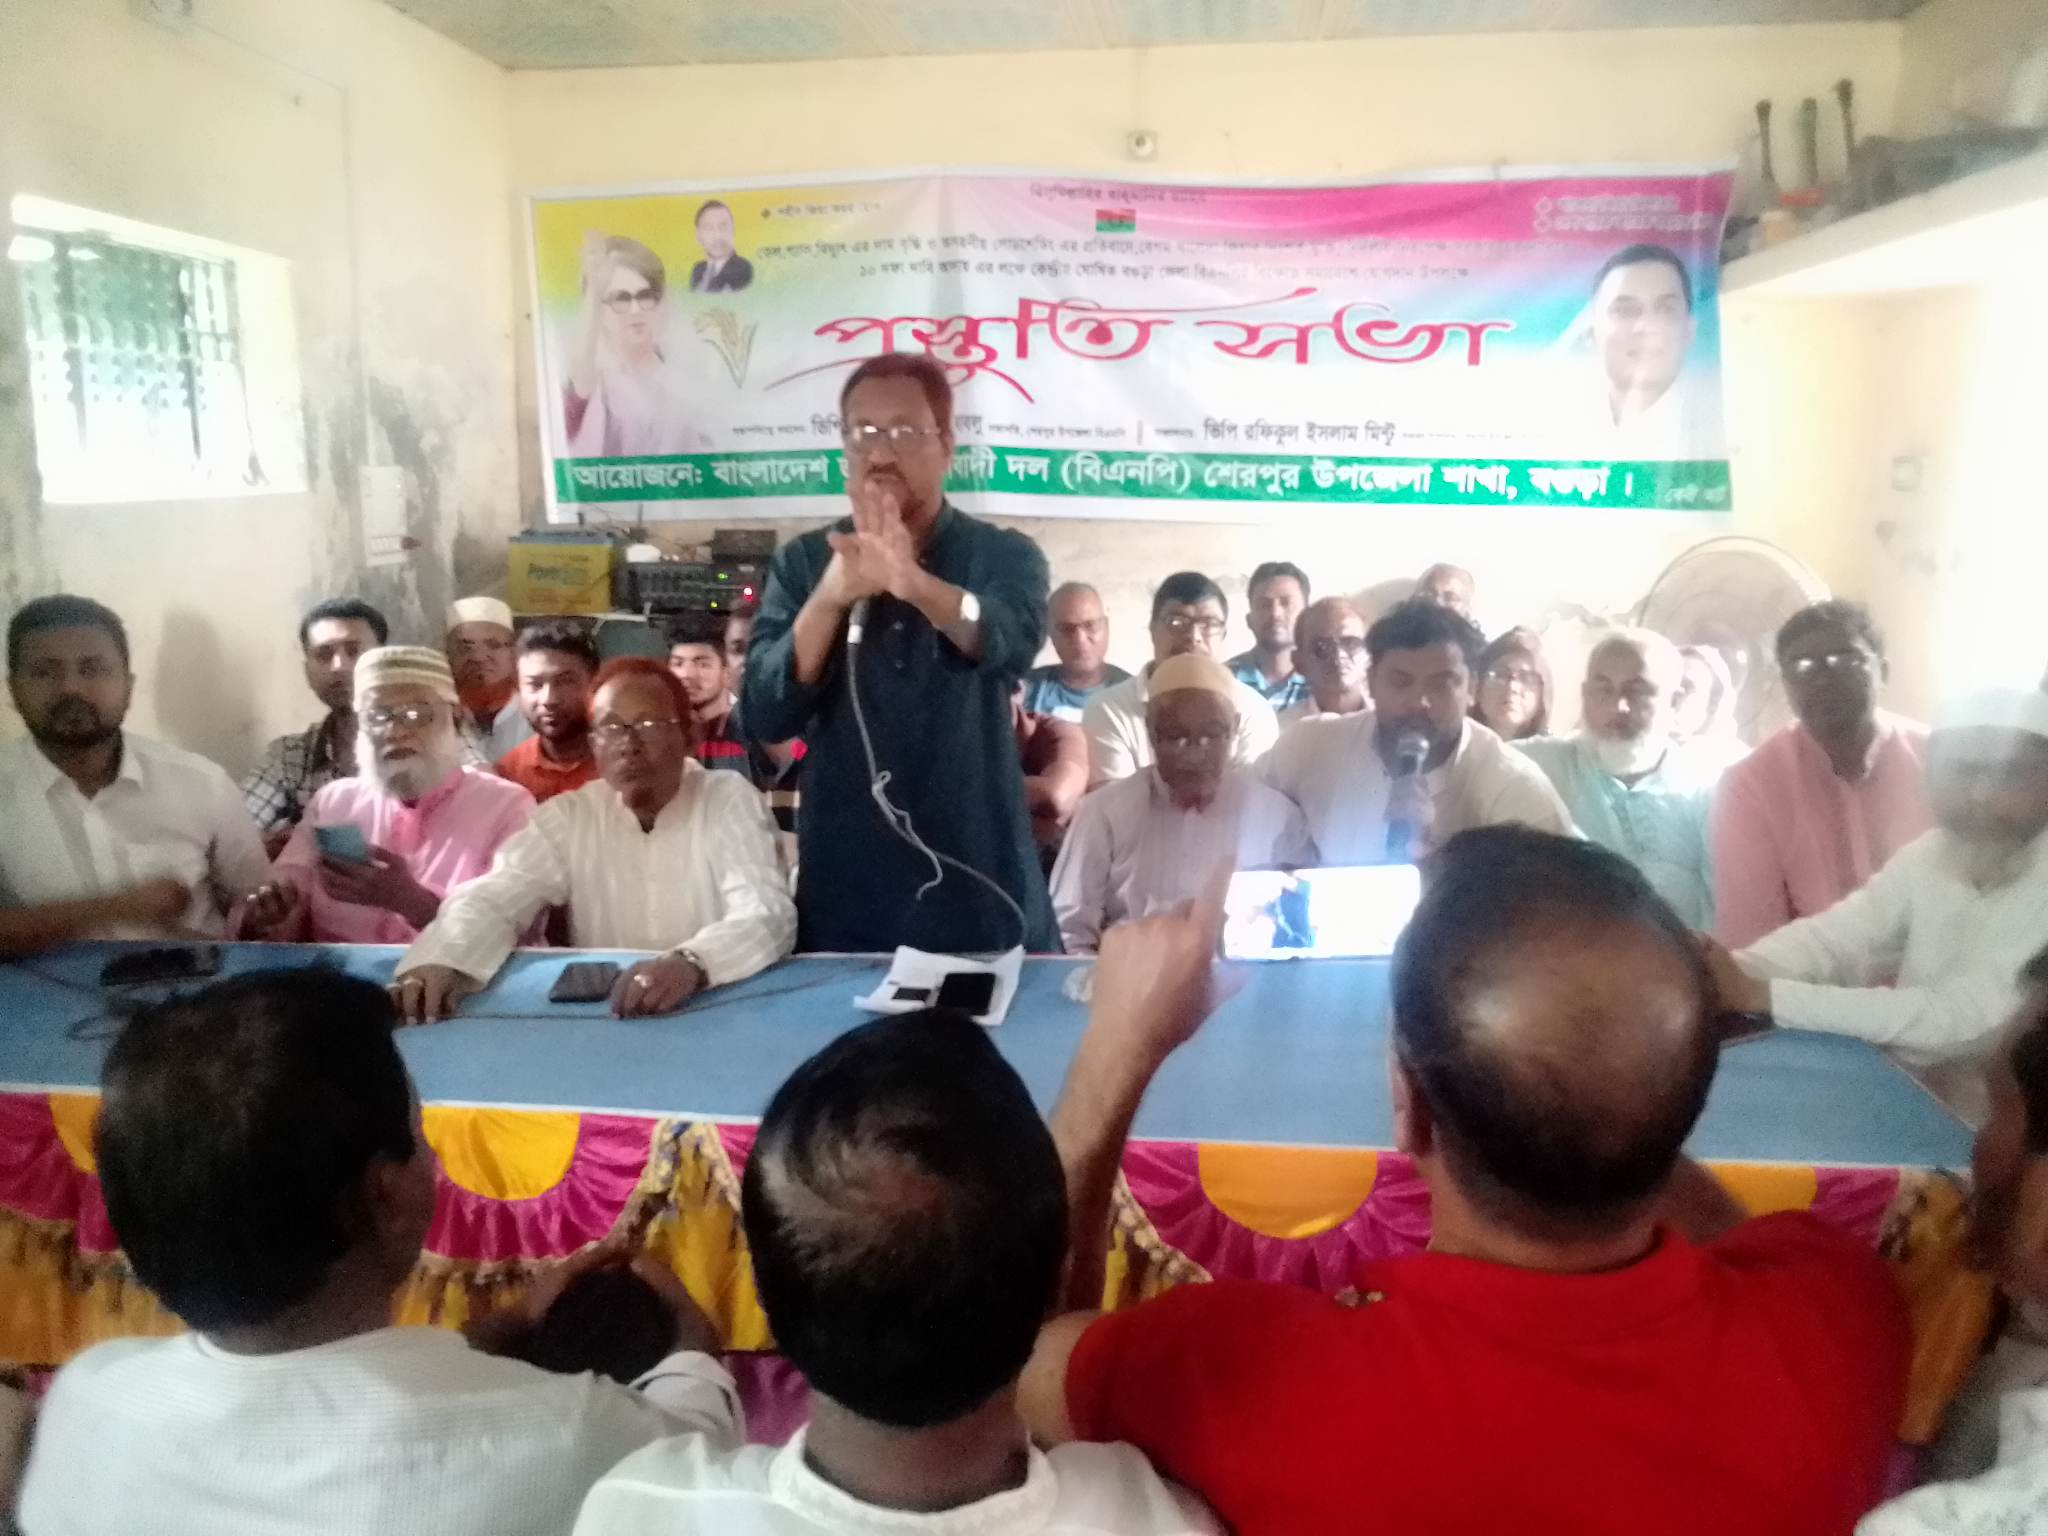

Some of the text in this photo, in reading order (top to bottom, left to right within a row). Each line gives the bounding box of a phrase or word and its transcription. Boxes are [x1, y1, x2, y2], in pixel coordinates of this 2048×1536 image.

[1194, 303, 1514, 365] সভা
[1306, 420, 1358, 441] ইসলাম
[711, 455, 829, 487] বাংলাদেশ
[1005, 454, 1051, 483] দল
[1060, 450, 1192, 494] (বিএনপি)
[1203, 459, 1301, 497] শেরপুর
[1309, 456, 1434, 494] উপজেলা
[1527, 466, 1611, 501] বগুড়া
